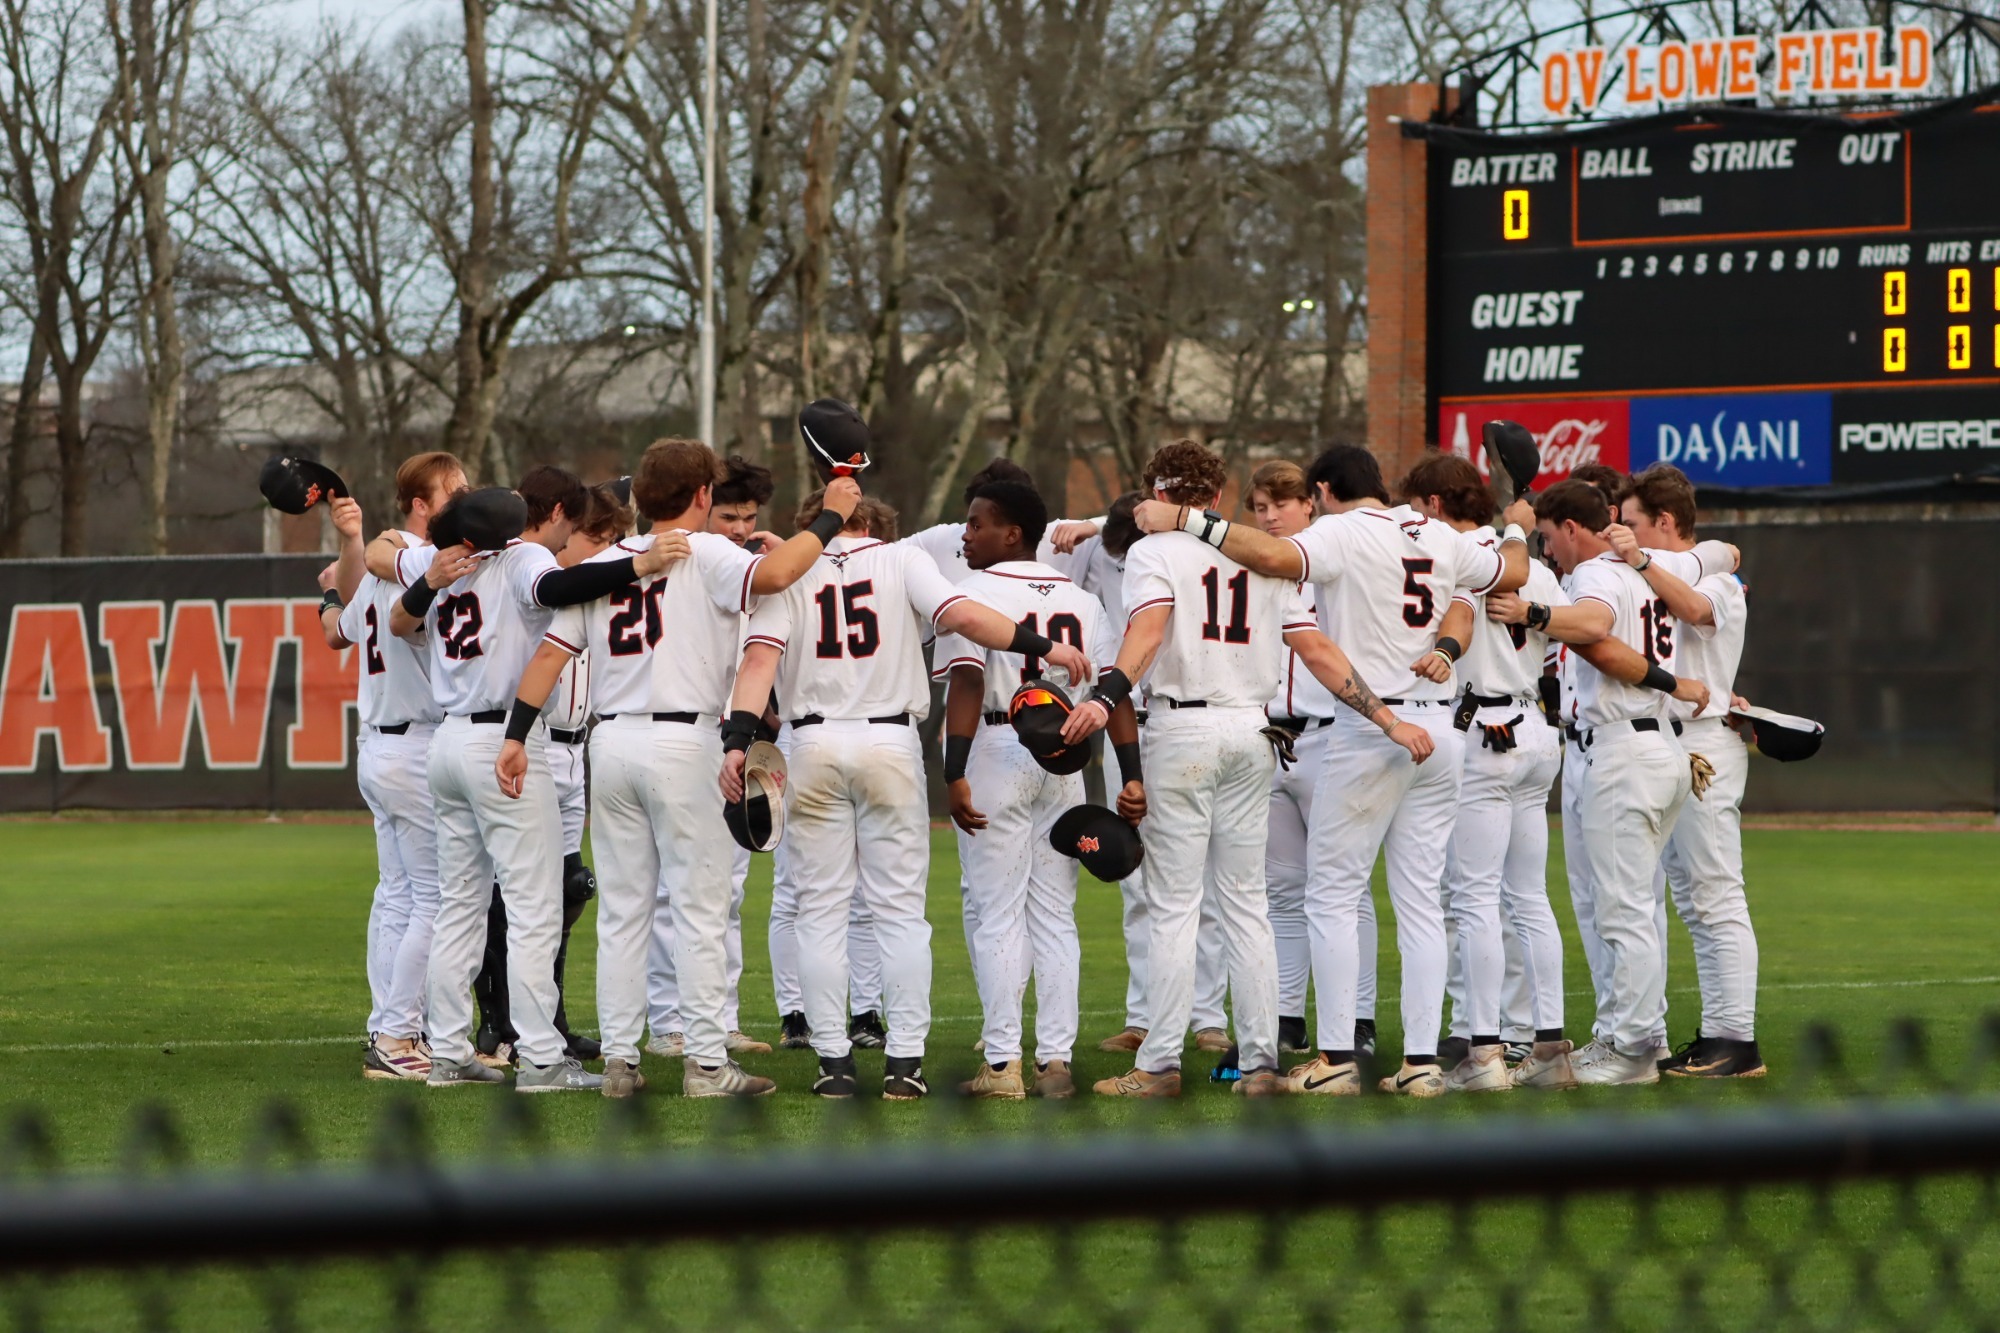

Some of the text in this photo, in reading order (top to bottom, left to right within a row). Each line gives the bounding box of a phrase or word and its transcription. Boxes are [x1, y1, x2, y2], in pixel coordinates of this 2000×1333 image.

[1543, 27, 1930, 114] QV LOWE FIELD
[1451, 153, 1557, 187] BATTER
[1580, 132, 1901, 179] BALL STRIKE OUT
[1503, 189, 1529, 240] 0
[1597, 247, 1840, 279] 1 2 3 4 5 6 7 8 9 10
[1858, 243, 1911, 266] RUNS
[1926, 241, 1972, 263] HITS
[1471, 290, 1584, 329] GUEST
[1883, 270, 1906, 316] 0
[1948, 268, 1971, 313] 0
[1483, 344, 1584, 382] HOME
[1883, 327, 1906, 373] 0
[1948, 325, 1971, 370] 0
[1658, 411, 1798, 472] DASANI
[1201, 565, 1251, 644] 11
[1401, 556, 1434, 628] 5
[365, 603, 386, 675] 2
[815, 578, 881, 660] 15
